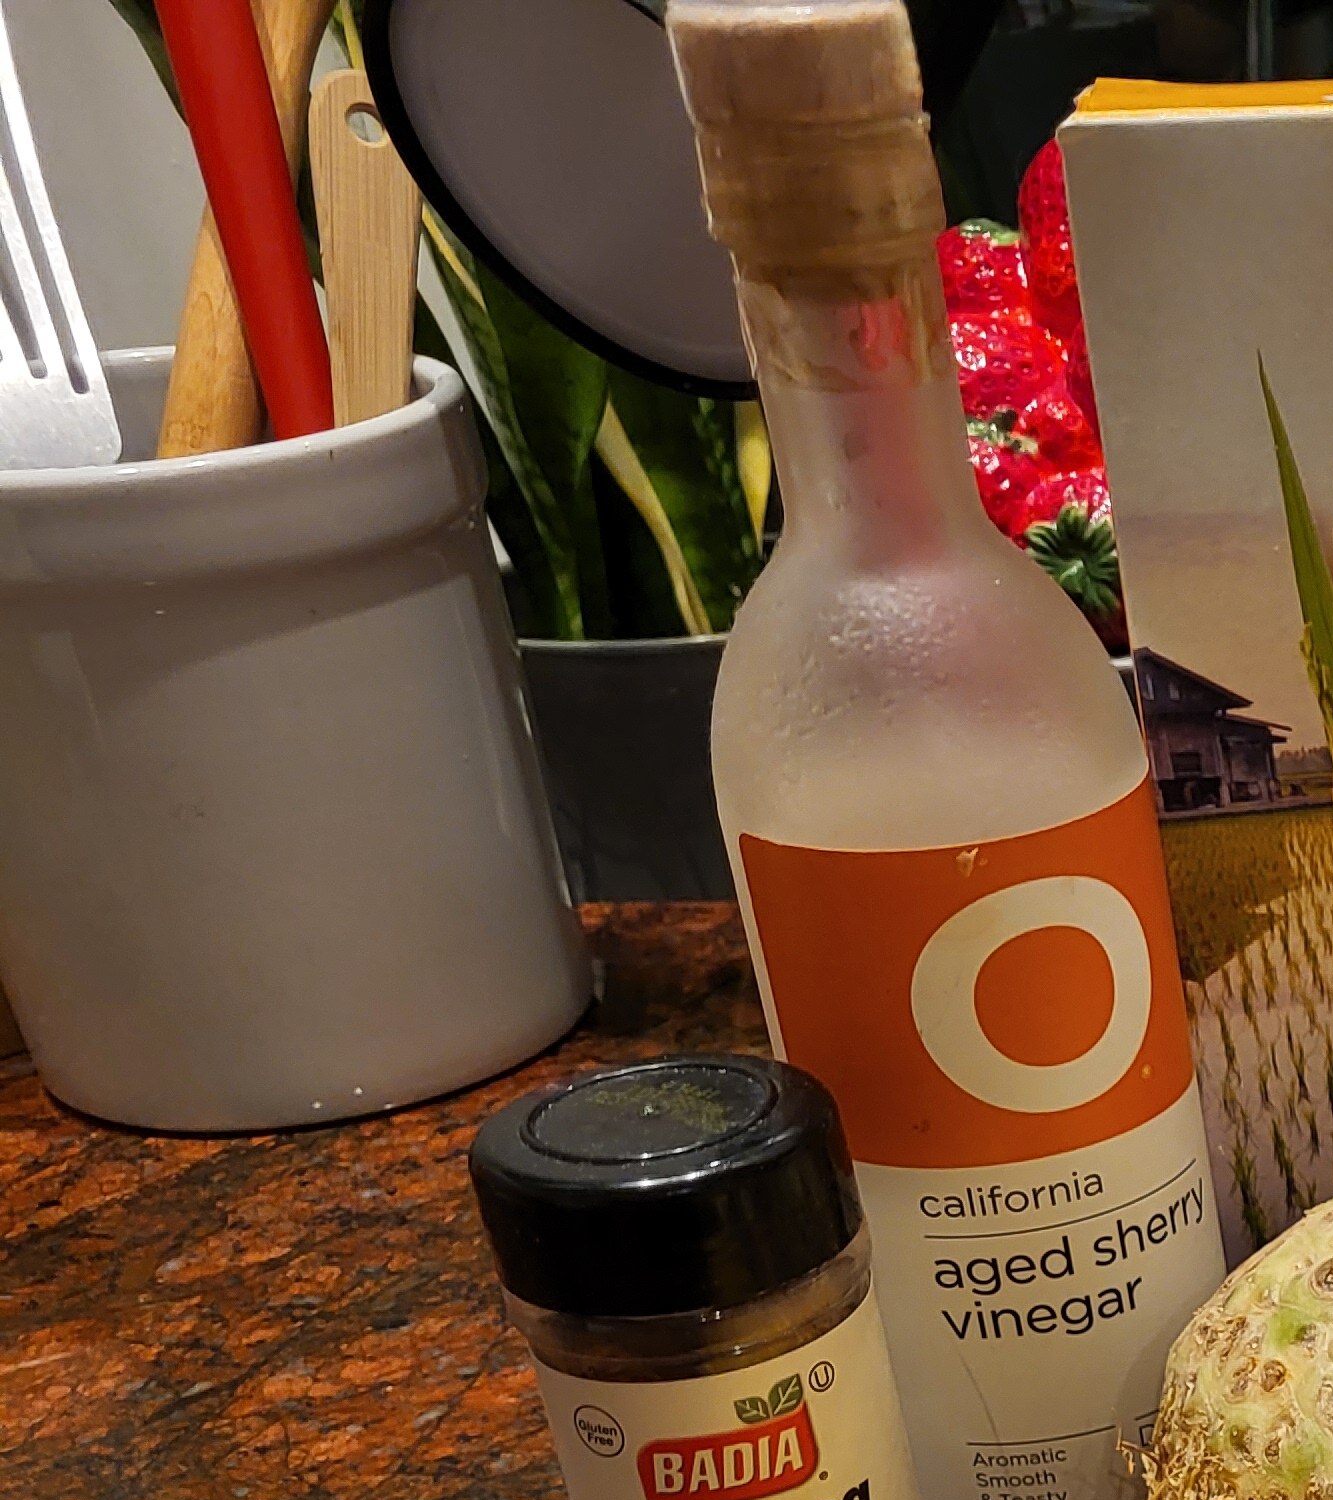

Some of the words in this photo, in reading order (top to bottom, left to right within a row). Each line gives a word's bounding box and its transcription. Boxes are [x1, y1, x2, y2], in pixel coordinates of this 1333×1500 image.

[920, 1171, 1104, 1219] california
[934, 1235, 1074, 1296] aged
[1094, 1177, 1204, 1267] sherry
[942, 1276, 1143, 1339] vinegar
[578, 1418, 618, 1437] Gluten
[587, 1431, 615, 1447] Free
[653, 1427, 804, 1495] BADIA
[973, 1448, 1067, 1467] Aromatic
[976, 1470, 1056, 1488] Smooth
